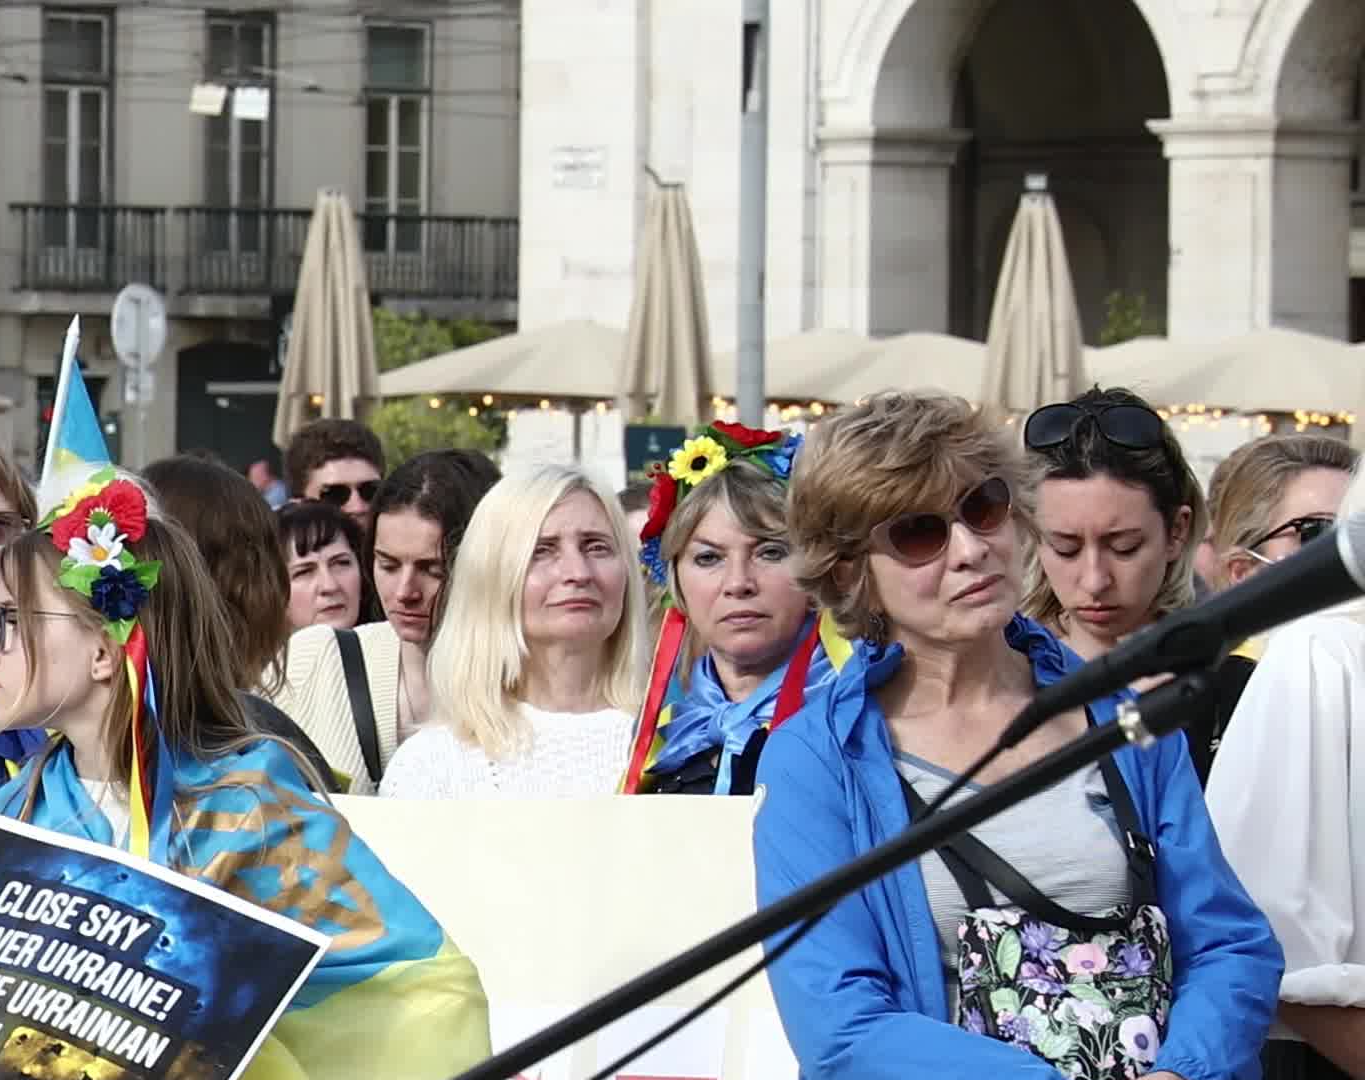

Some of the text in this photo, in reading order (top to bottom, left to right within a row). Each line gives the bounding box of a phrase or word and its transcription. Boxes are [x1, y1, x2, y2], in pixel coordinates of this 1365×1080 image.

[79, 903, 151, 952] SKY
[37, 939, 183, 1022] UKRAINE!
[6, 980, 171, 1069] UKRAINIAN
